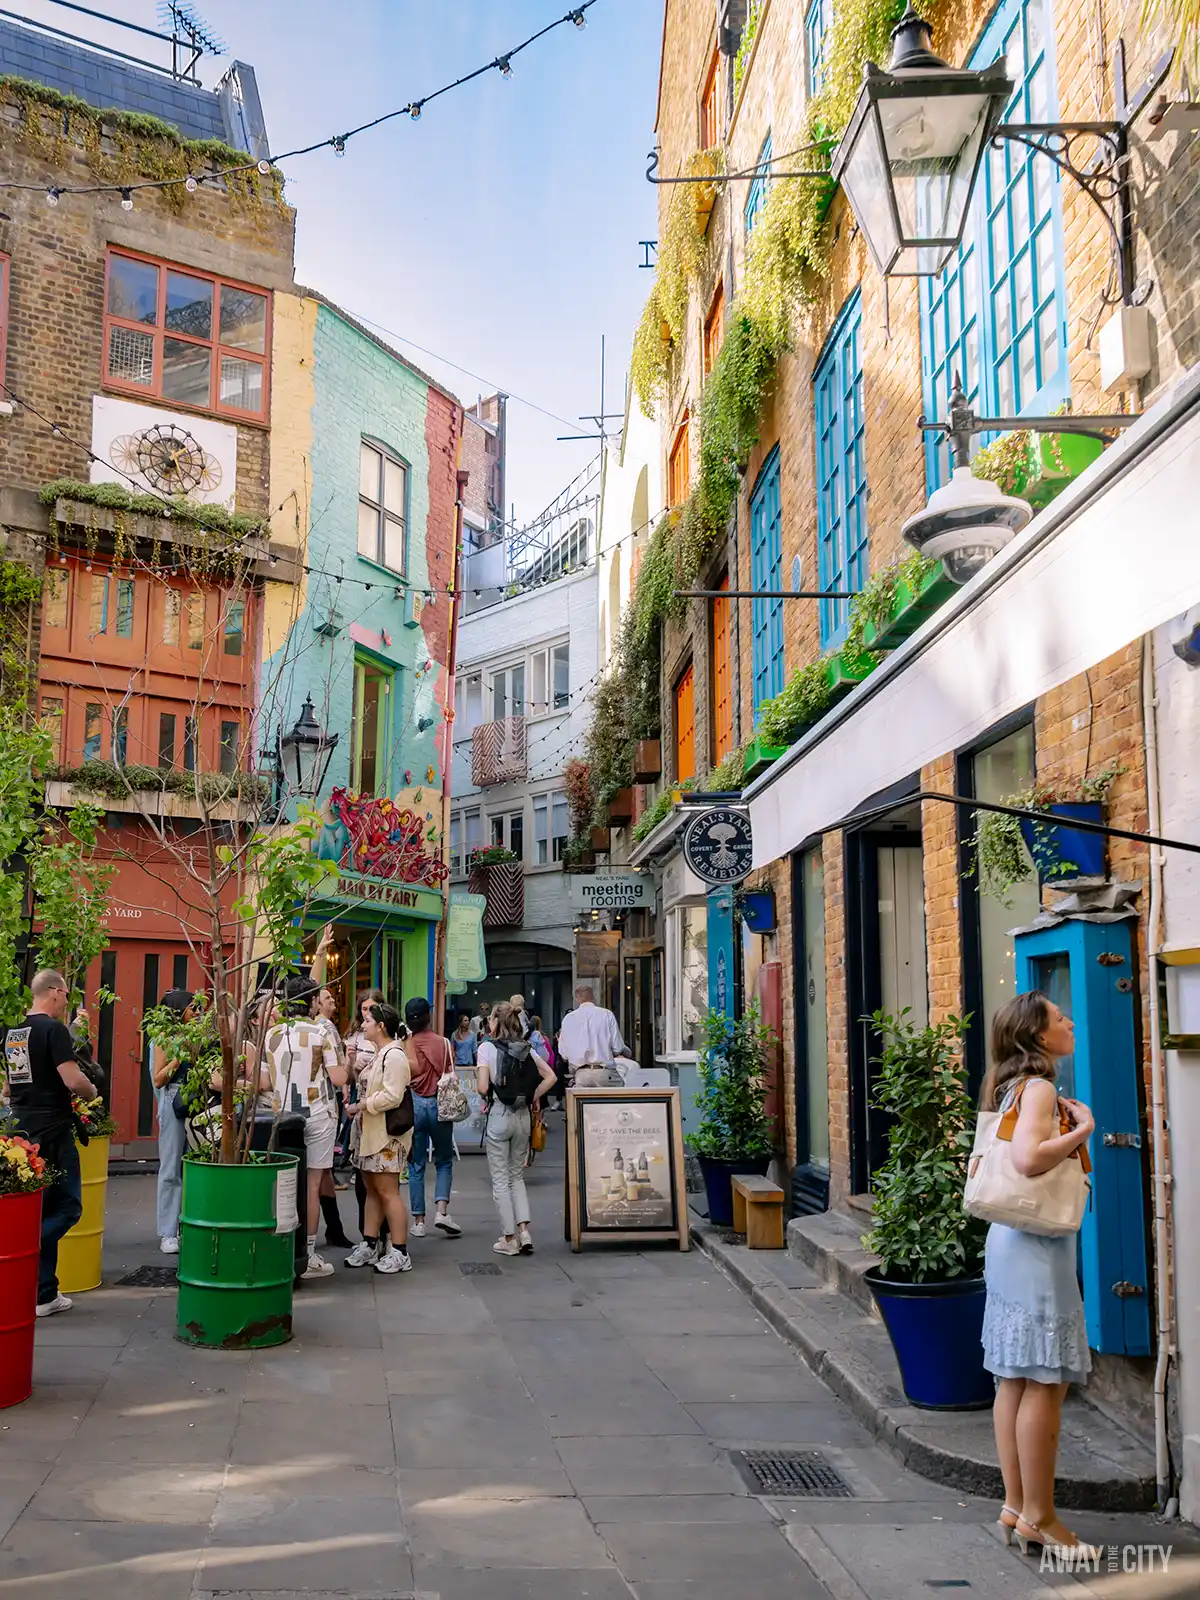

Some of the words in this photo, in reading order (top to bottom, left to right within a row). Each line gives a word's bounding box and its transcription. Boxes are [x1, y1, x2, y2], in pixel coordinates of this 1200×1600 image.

[691, 813, 724, 843] NEAL'S
[694, 852, 752, 878] REMEDIES
[337, 878, 366, 897] HAIR
[385, 887, 418, 907] FAIRY
[582, 883, 643, 897] meeting
[591, 895, 635, 906] rooms
[114, 907, 142, 918] YARD
[609, 1127, 628, 1135] SAVE
